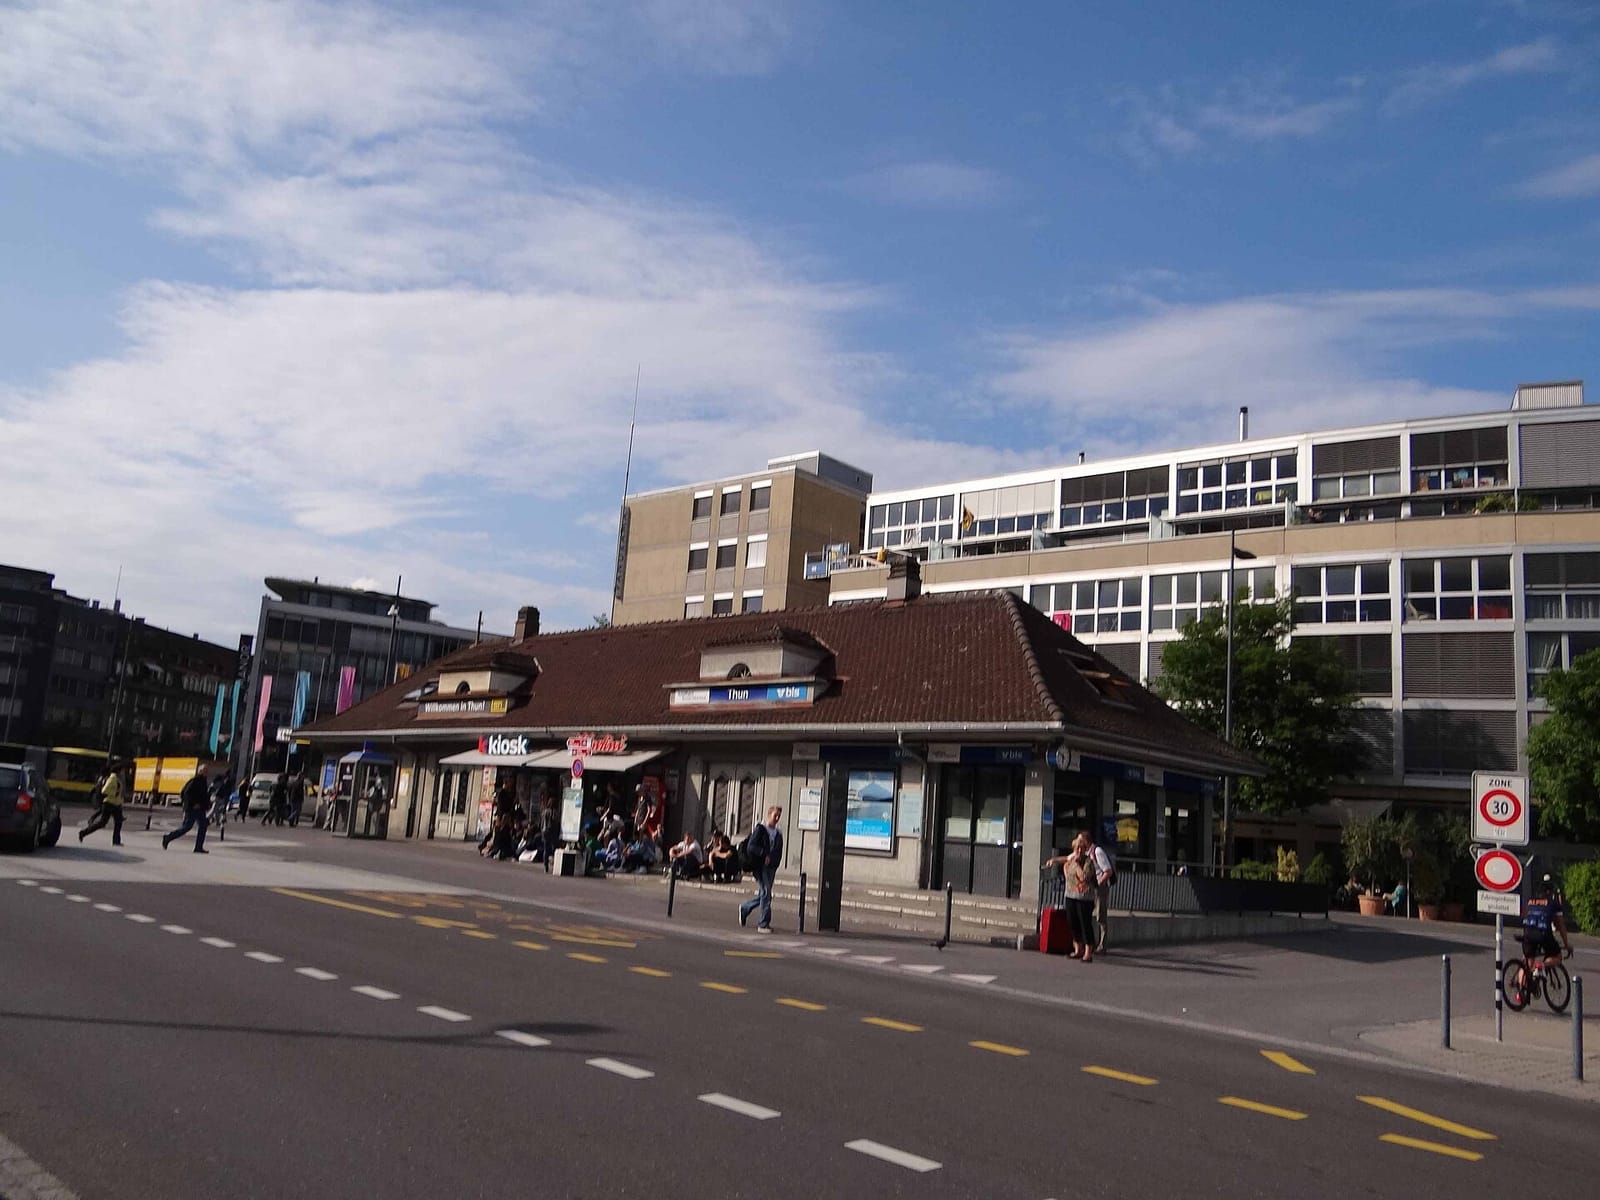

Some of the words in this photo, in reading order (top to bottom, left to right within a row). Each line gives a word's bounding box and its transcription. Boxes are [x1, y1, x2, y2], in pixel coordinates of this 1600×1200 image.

[728, 688, 749, 700] Thun
[424, 702, 460, 713] Willkommen
[460, 701, 467, 712] in
[488, 734, 528, 756] kiosk
[1489, 779, 1513, 788] ZONE
[1492, 801, 1509, 815] 30
